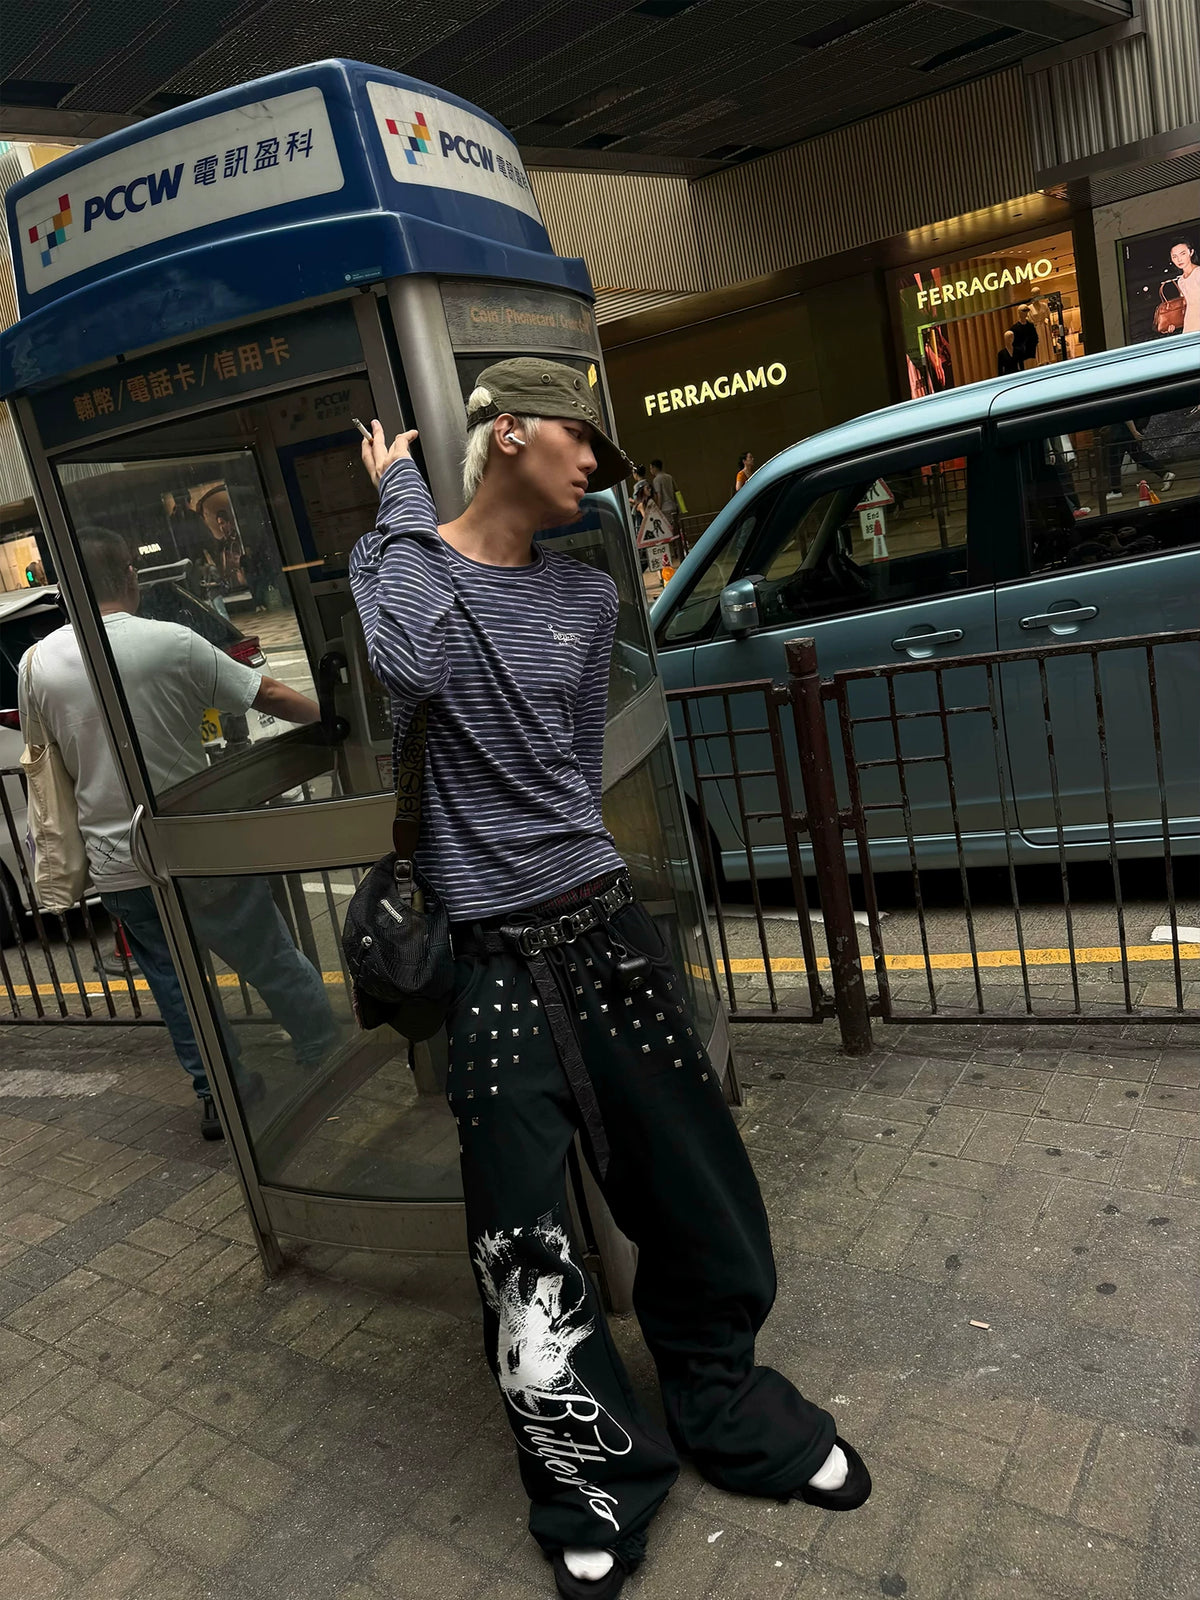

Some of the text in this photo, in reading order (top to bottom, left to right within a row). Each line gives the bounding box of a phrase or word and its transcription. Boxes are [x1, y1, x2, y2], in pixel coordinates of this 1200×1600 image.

[438, 130, 495, 173] PCCW
[84, 127, 314, 233] PCCW 電訊盈科
[916, 258, 1053, 311] FERRAGAMO
[314, 389, 351, 410] PCCW
[644, 361, 788, 416] FERRAGAMO
[652, 546, 666, 555] End
